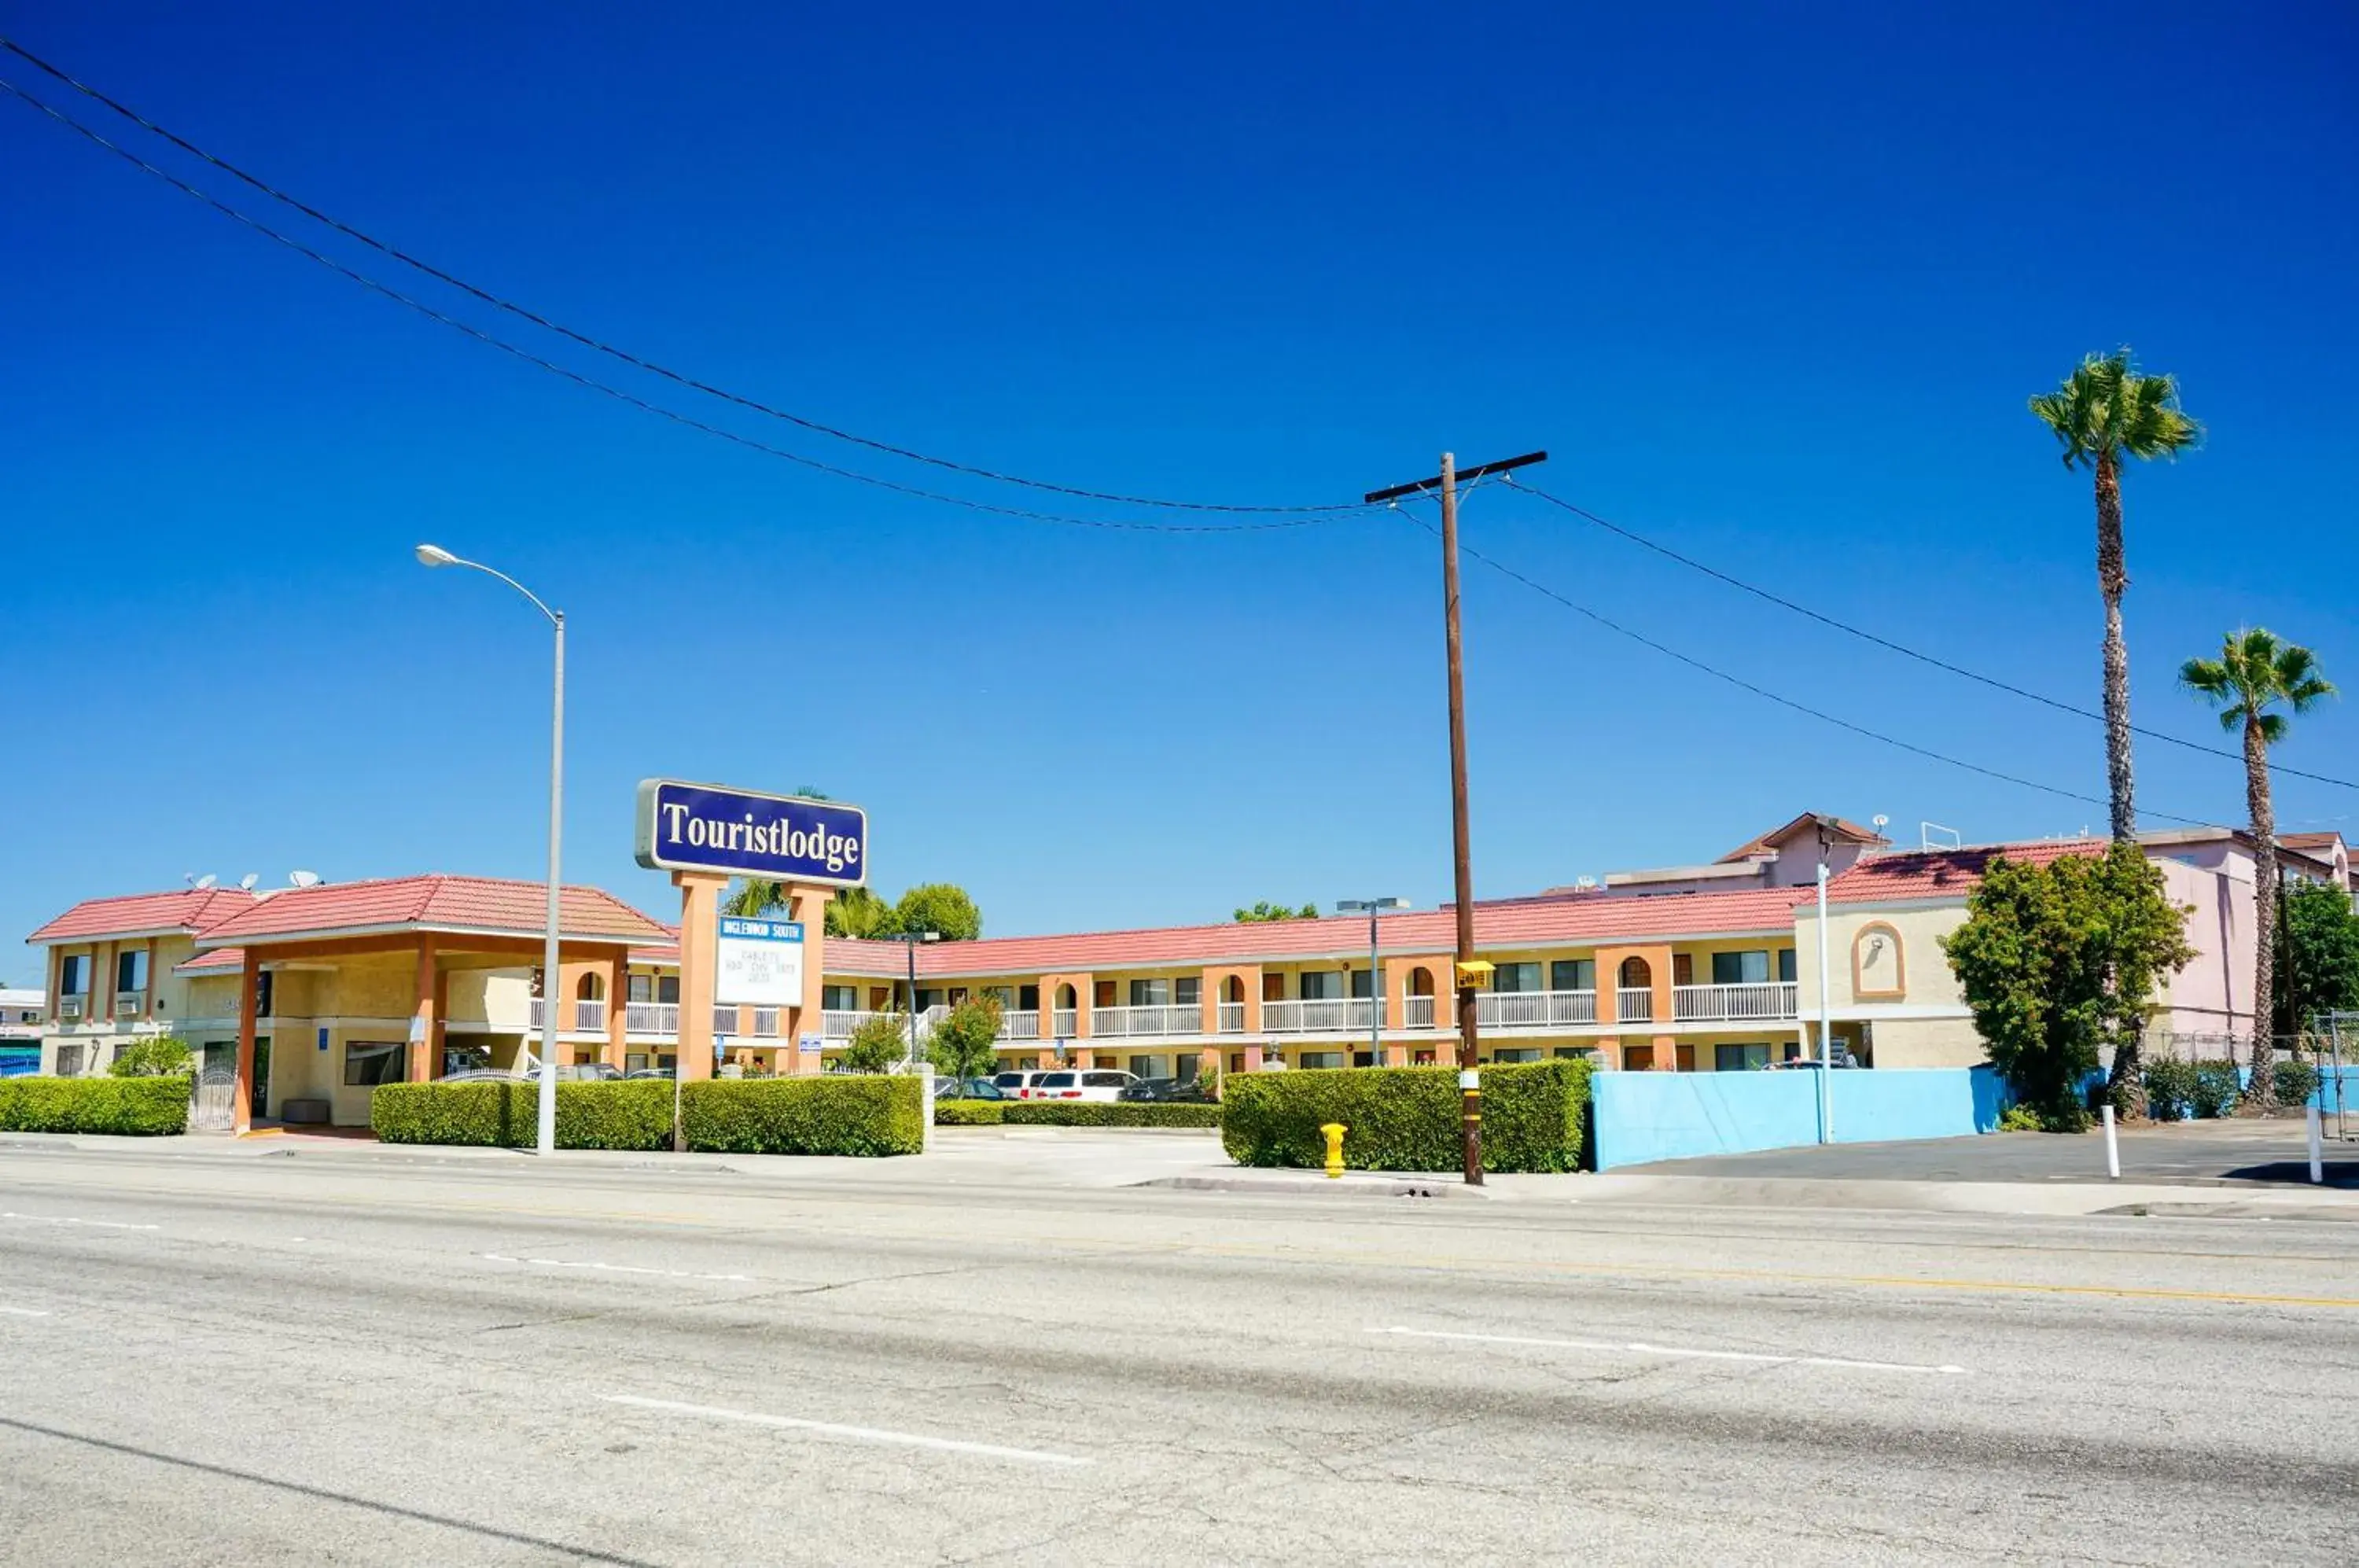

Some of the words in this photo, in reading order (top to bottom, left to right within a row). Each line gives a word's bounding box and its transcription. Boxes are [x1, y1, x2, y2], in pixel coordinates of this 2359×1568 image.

[663, 803, 859, 872] Touristlodge
[723, 921, 769, 936] INGLEWOOD
[773, 924, 800, 937] SOUTH
